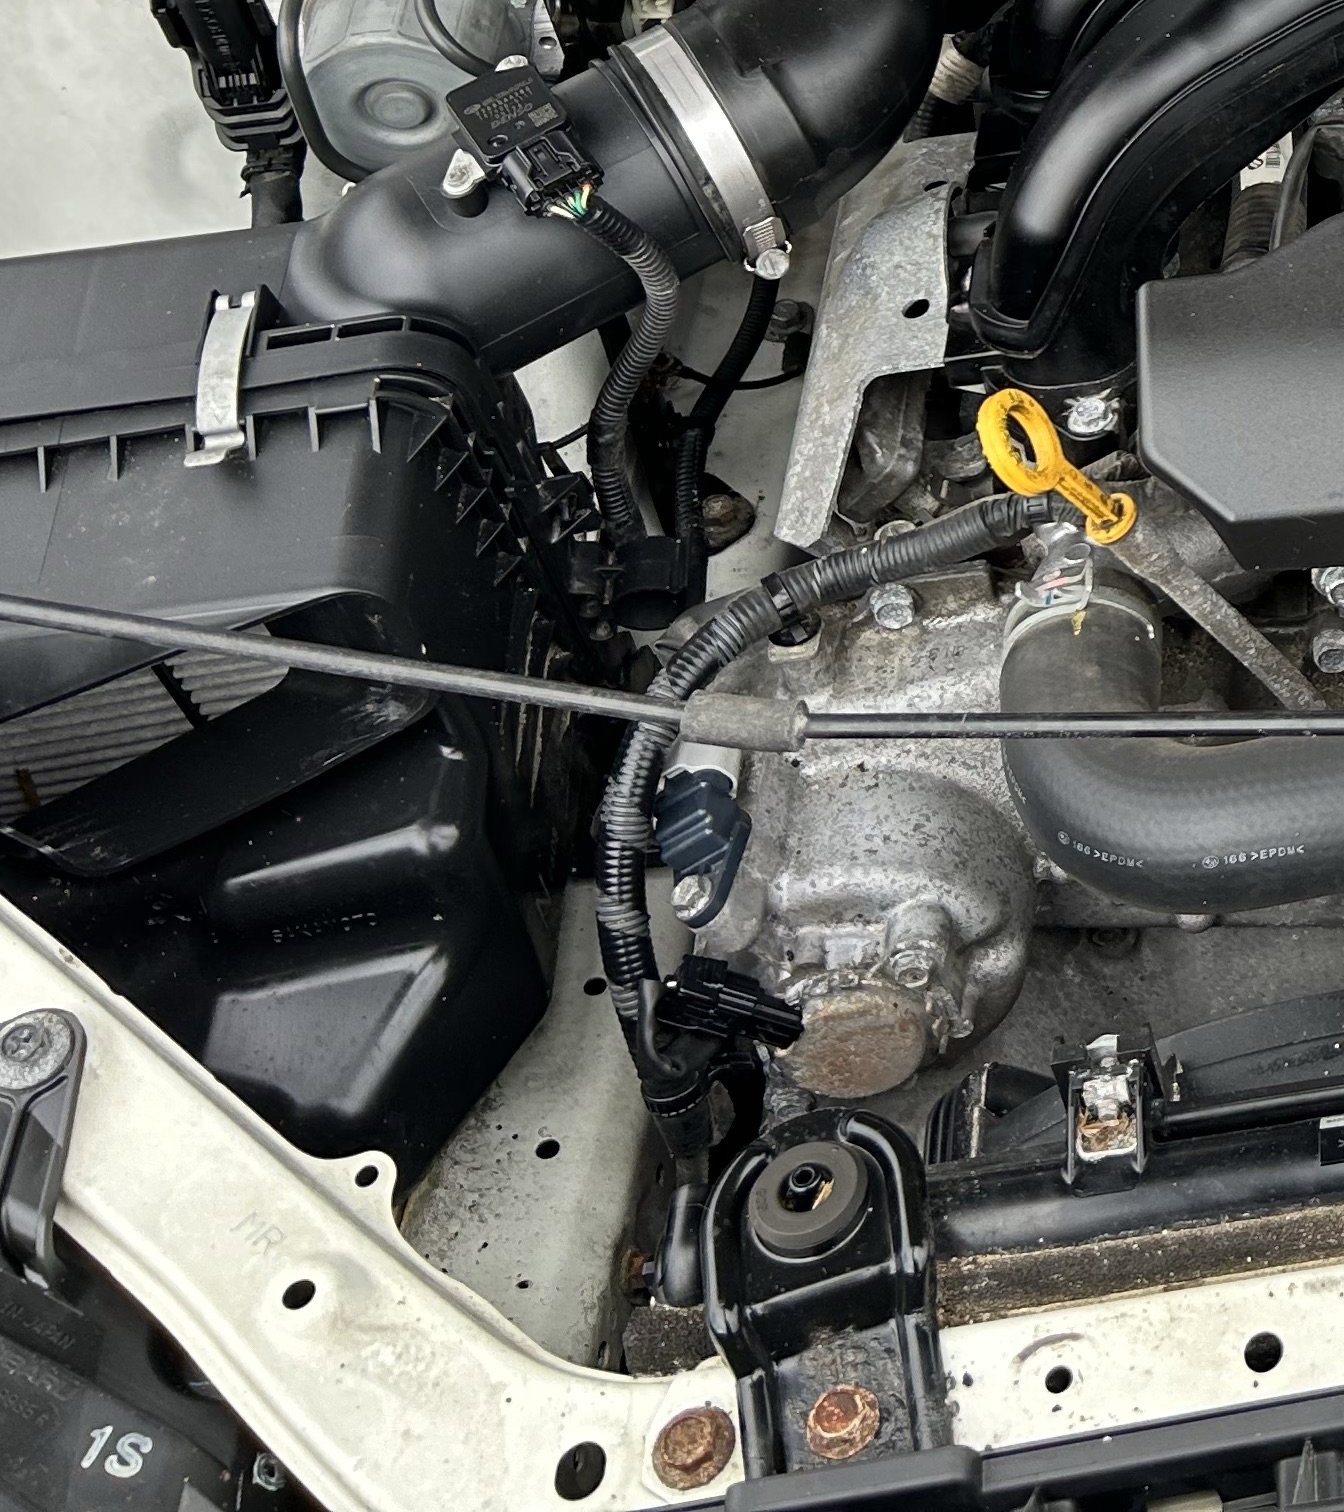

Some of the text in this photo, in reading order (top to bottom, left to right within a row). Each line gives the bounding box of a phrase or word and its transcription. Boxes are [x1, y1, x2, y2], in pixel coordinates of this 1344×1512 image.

[1222, 851, 1247, 866] 166
[228, 1210, 287, 1256] MR
[80, 1424, 154, 1479] 1S
